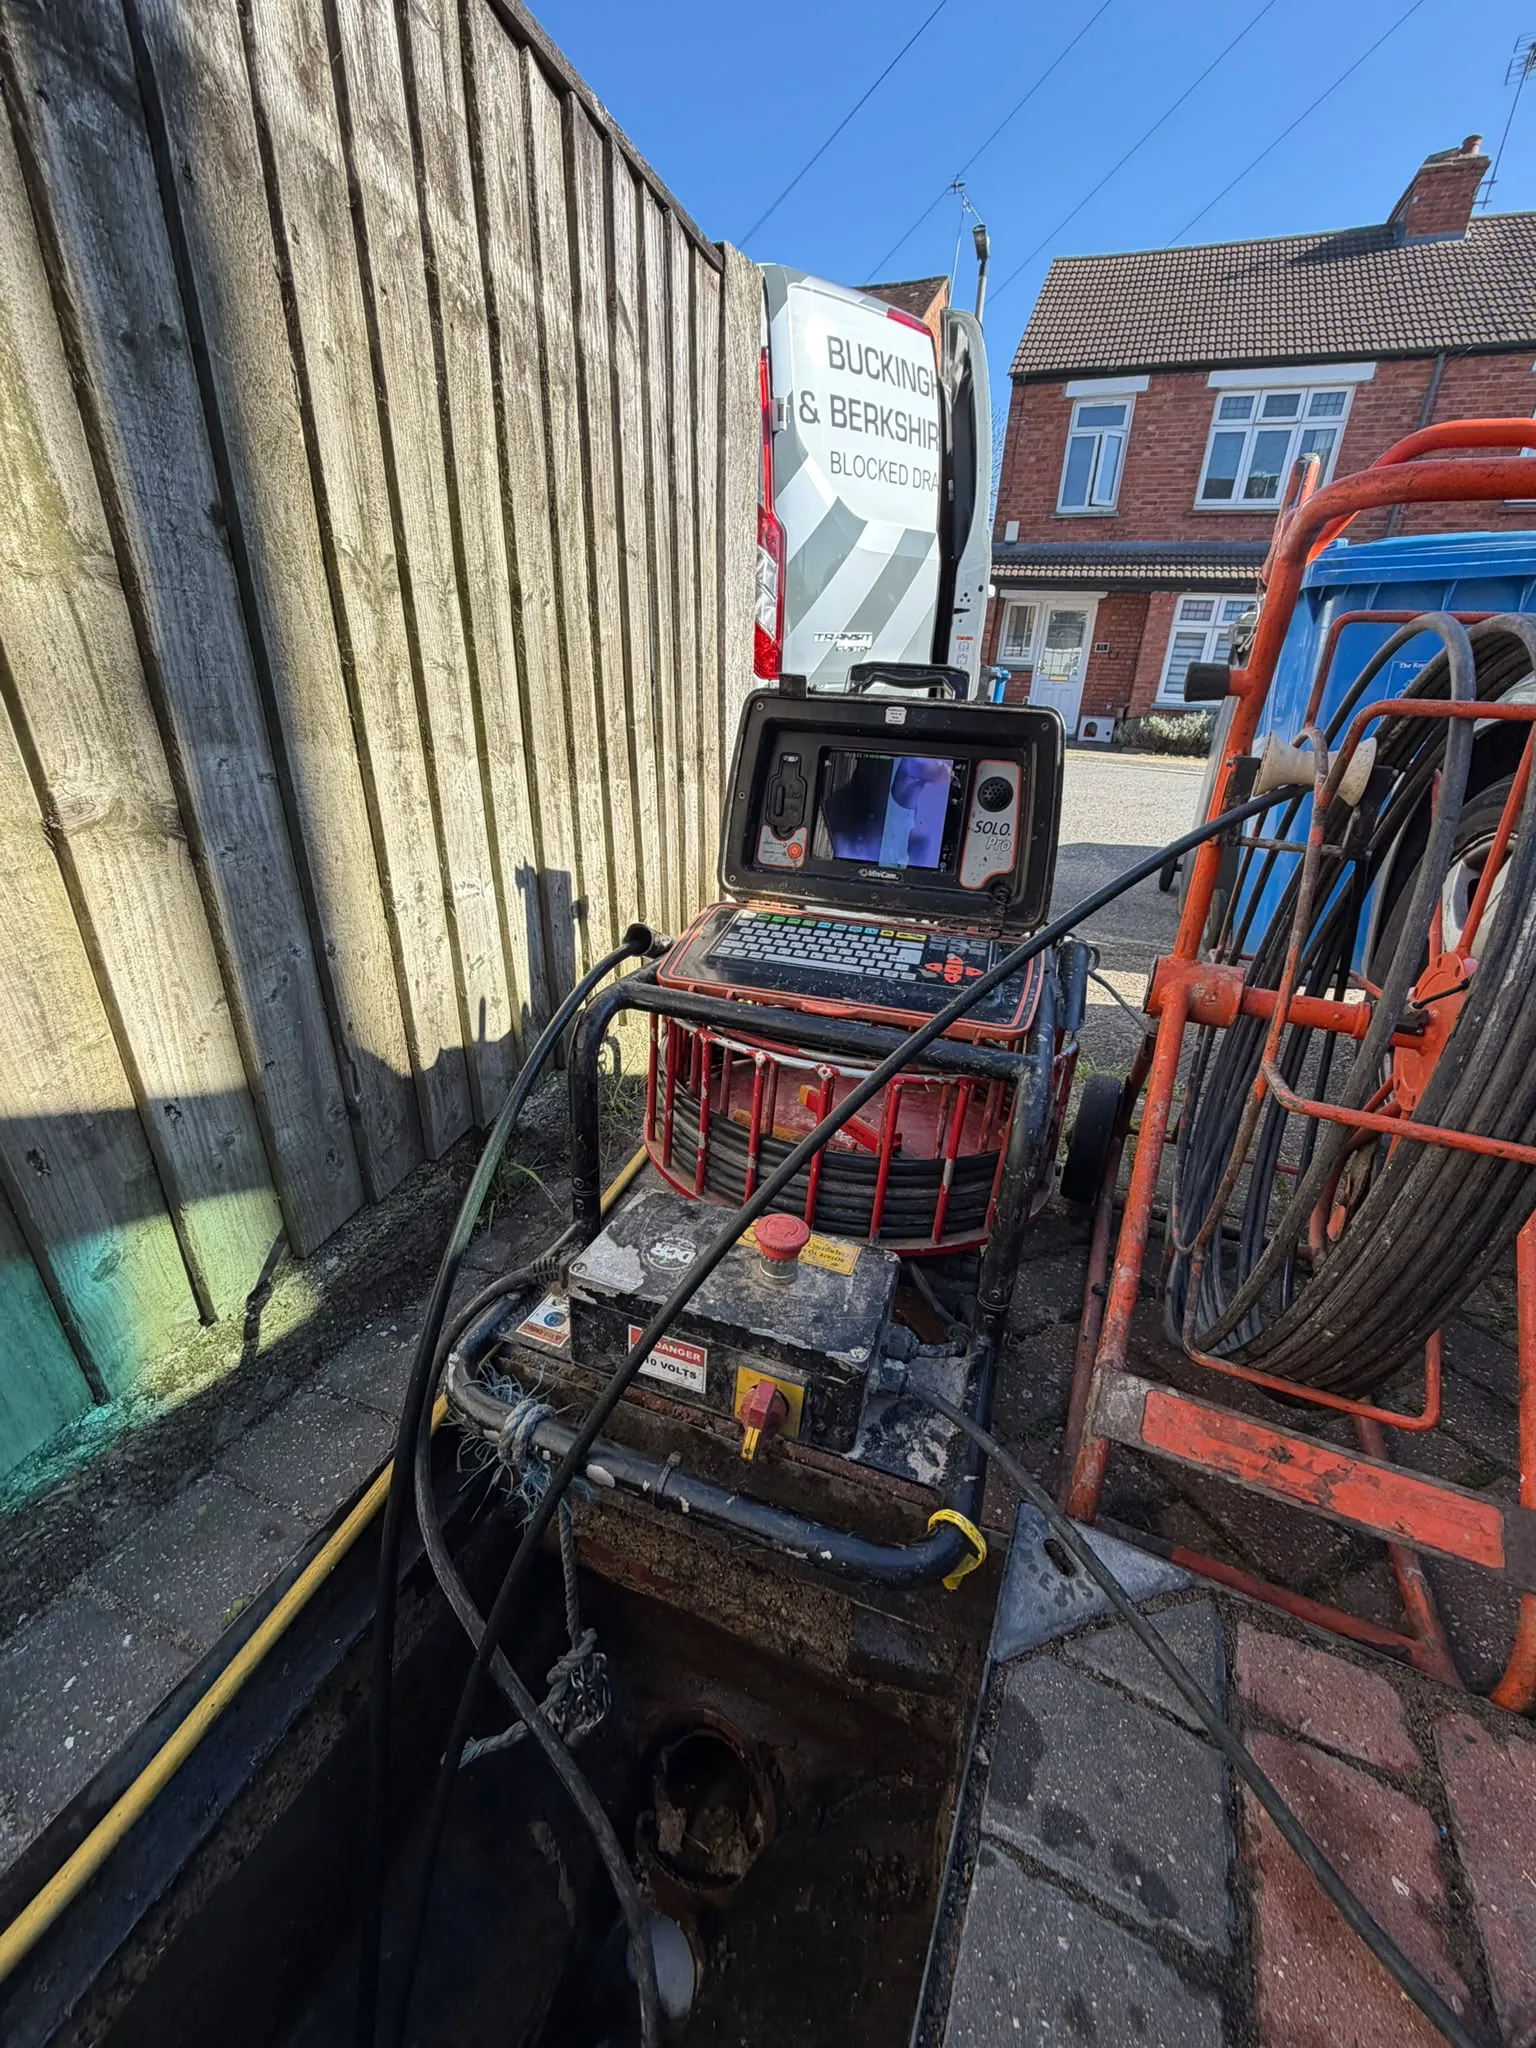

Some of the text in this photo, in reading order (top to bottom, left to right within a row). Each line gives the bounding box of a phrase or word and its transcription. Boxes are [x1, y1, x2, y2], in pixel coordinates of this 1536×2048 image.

[799, 389, 821, 424] &
[830, 450, 909, 486] BLOCKED
[813, 632, 872, 642] TRANSIT
[985, 836, 1012, 852] Pro
[655, 1341, 701, 1362] DANGER
[660, 1360, 697, 1380] VOLTS
